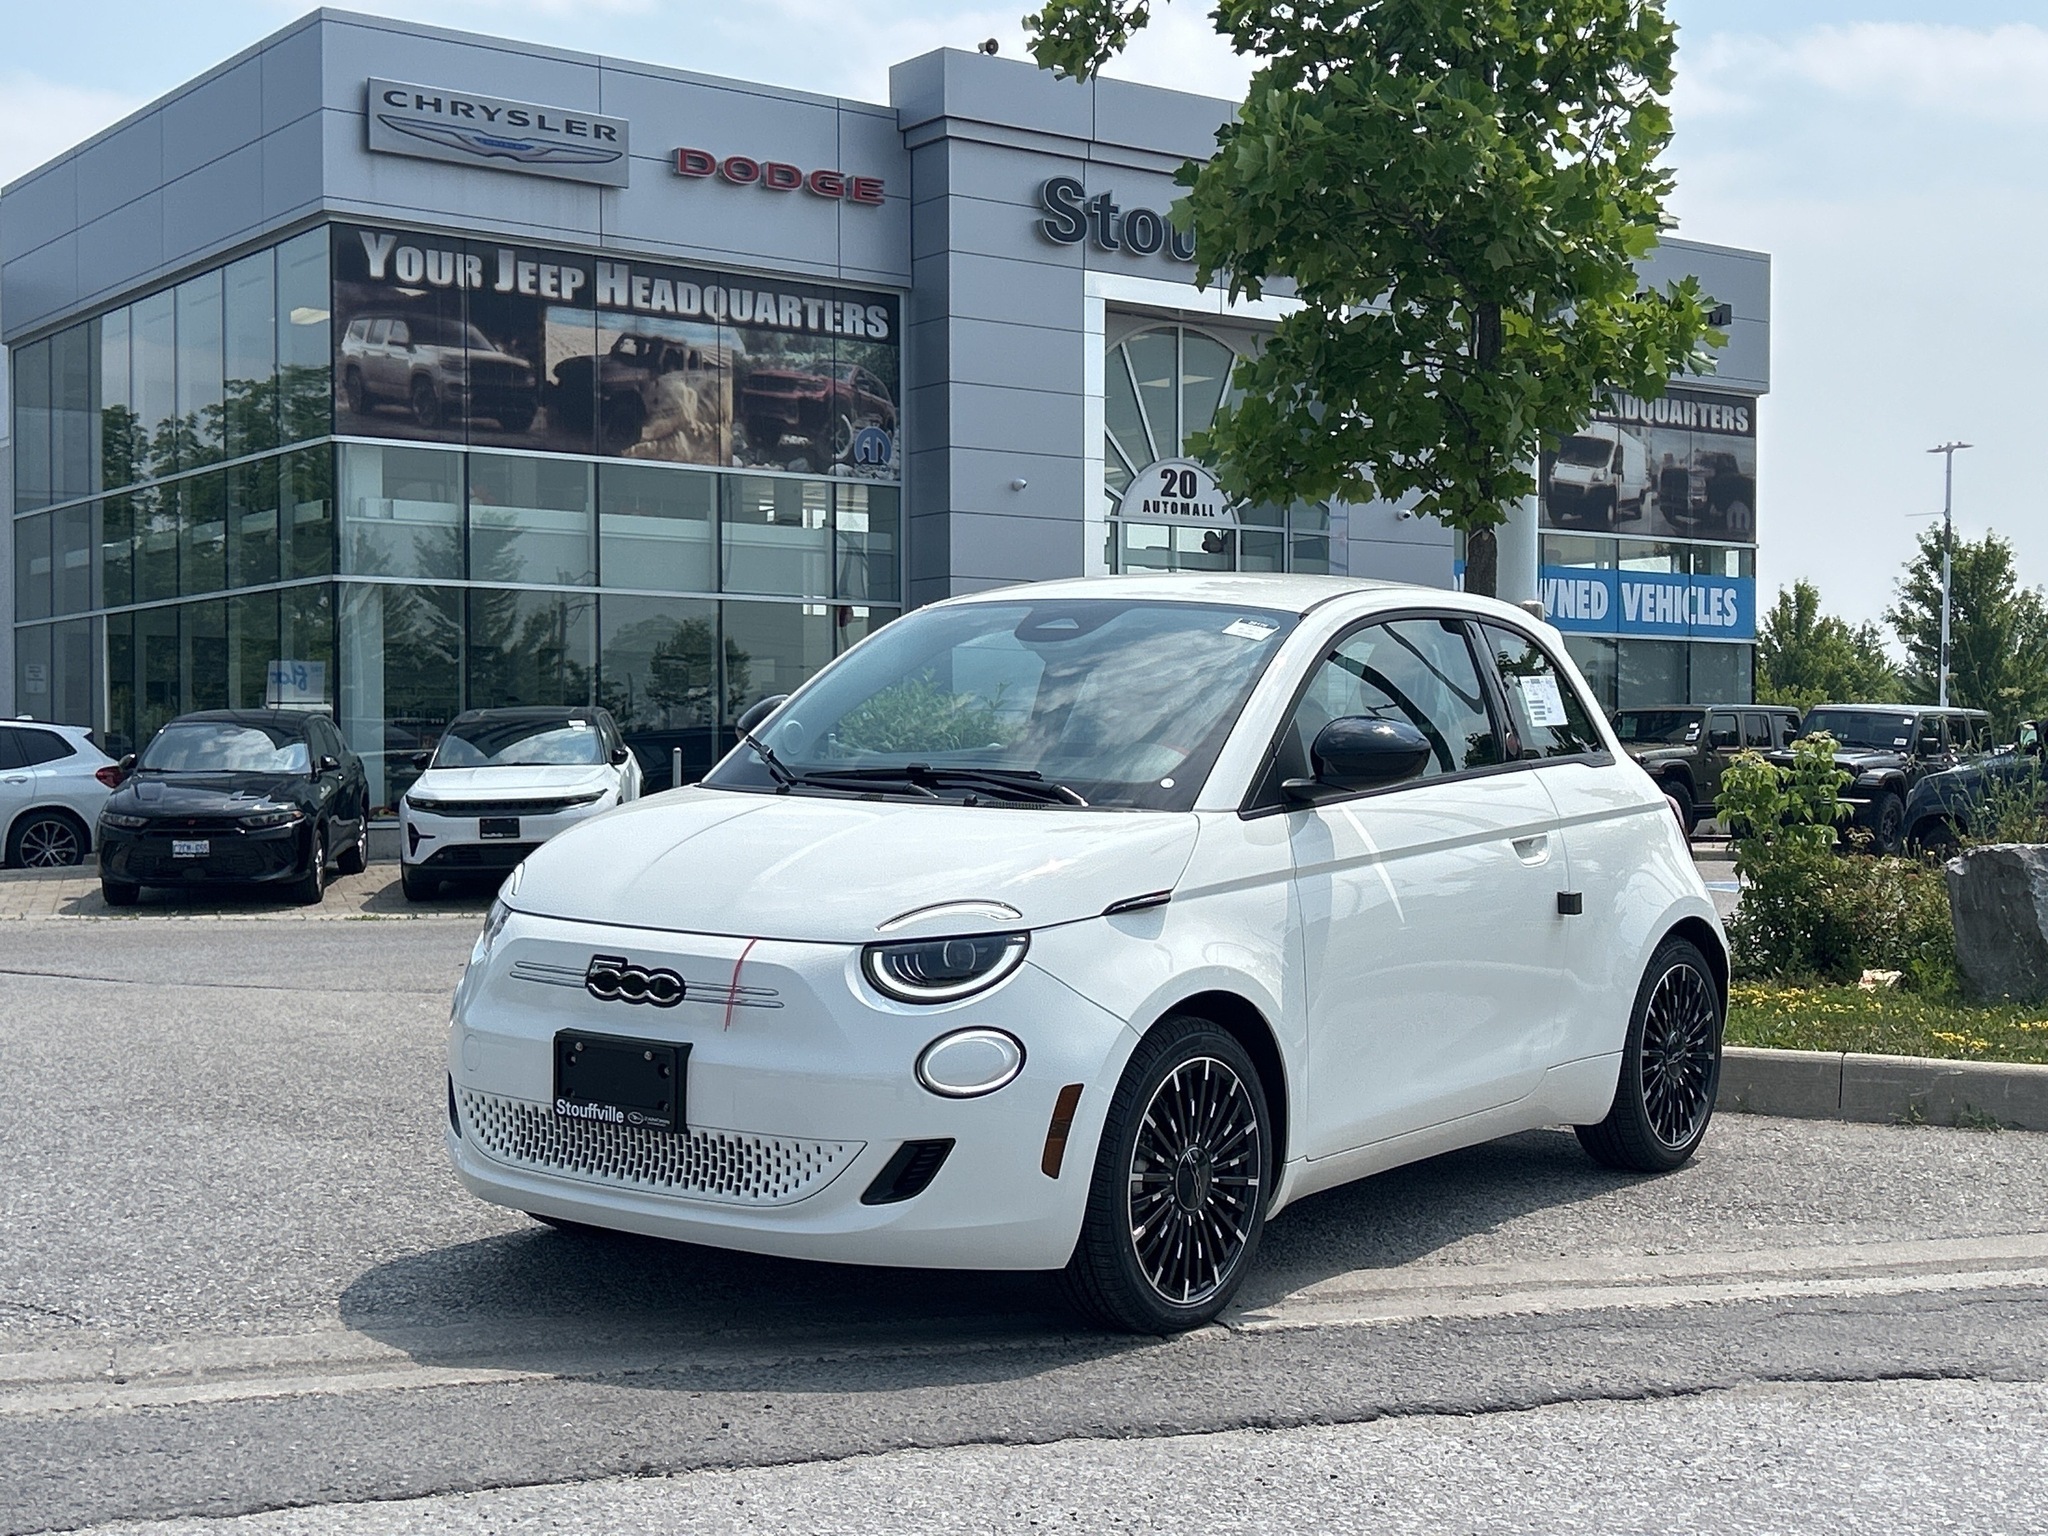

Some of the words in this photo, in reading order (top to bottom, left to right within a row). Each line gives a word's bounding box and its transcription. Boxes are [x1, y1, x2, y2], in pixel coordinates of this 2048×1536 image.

[383, 90, 617, 142] CHRYSLER
[674, 147, 885, 206] DODGE
[1161, 469, 1197, 499] 20
[1143, 500, 1215, 517] AUTOMALL
[1621, 582, 1738, 627] VEHICLES
[588, 957, 683, 1005] 500
[556, 1099, 624, 1123] Stouffville
